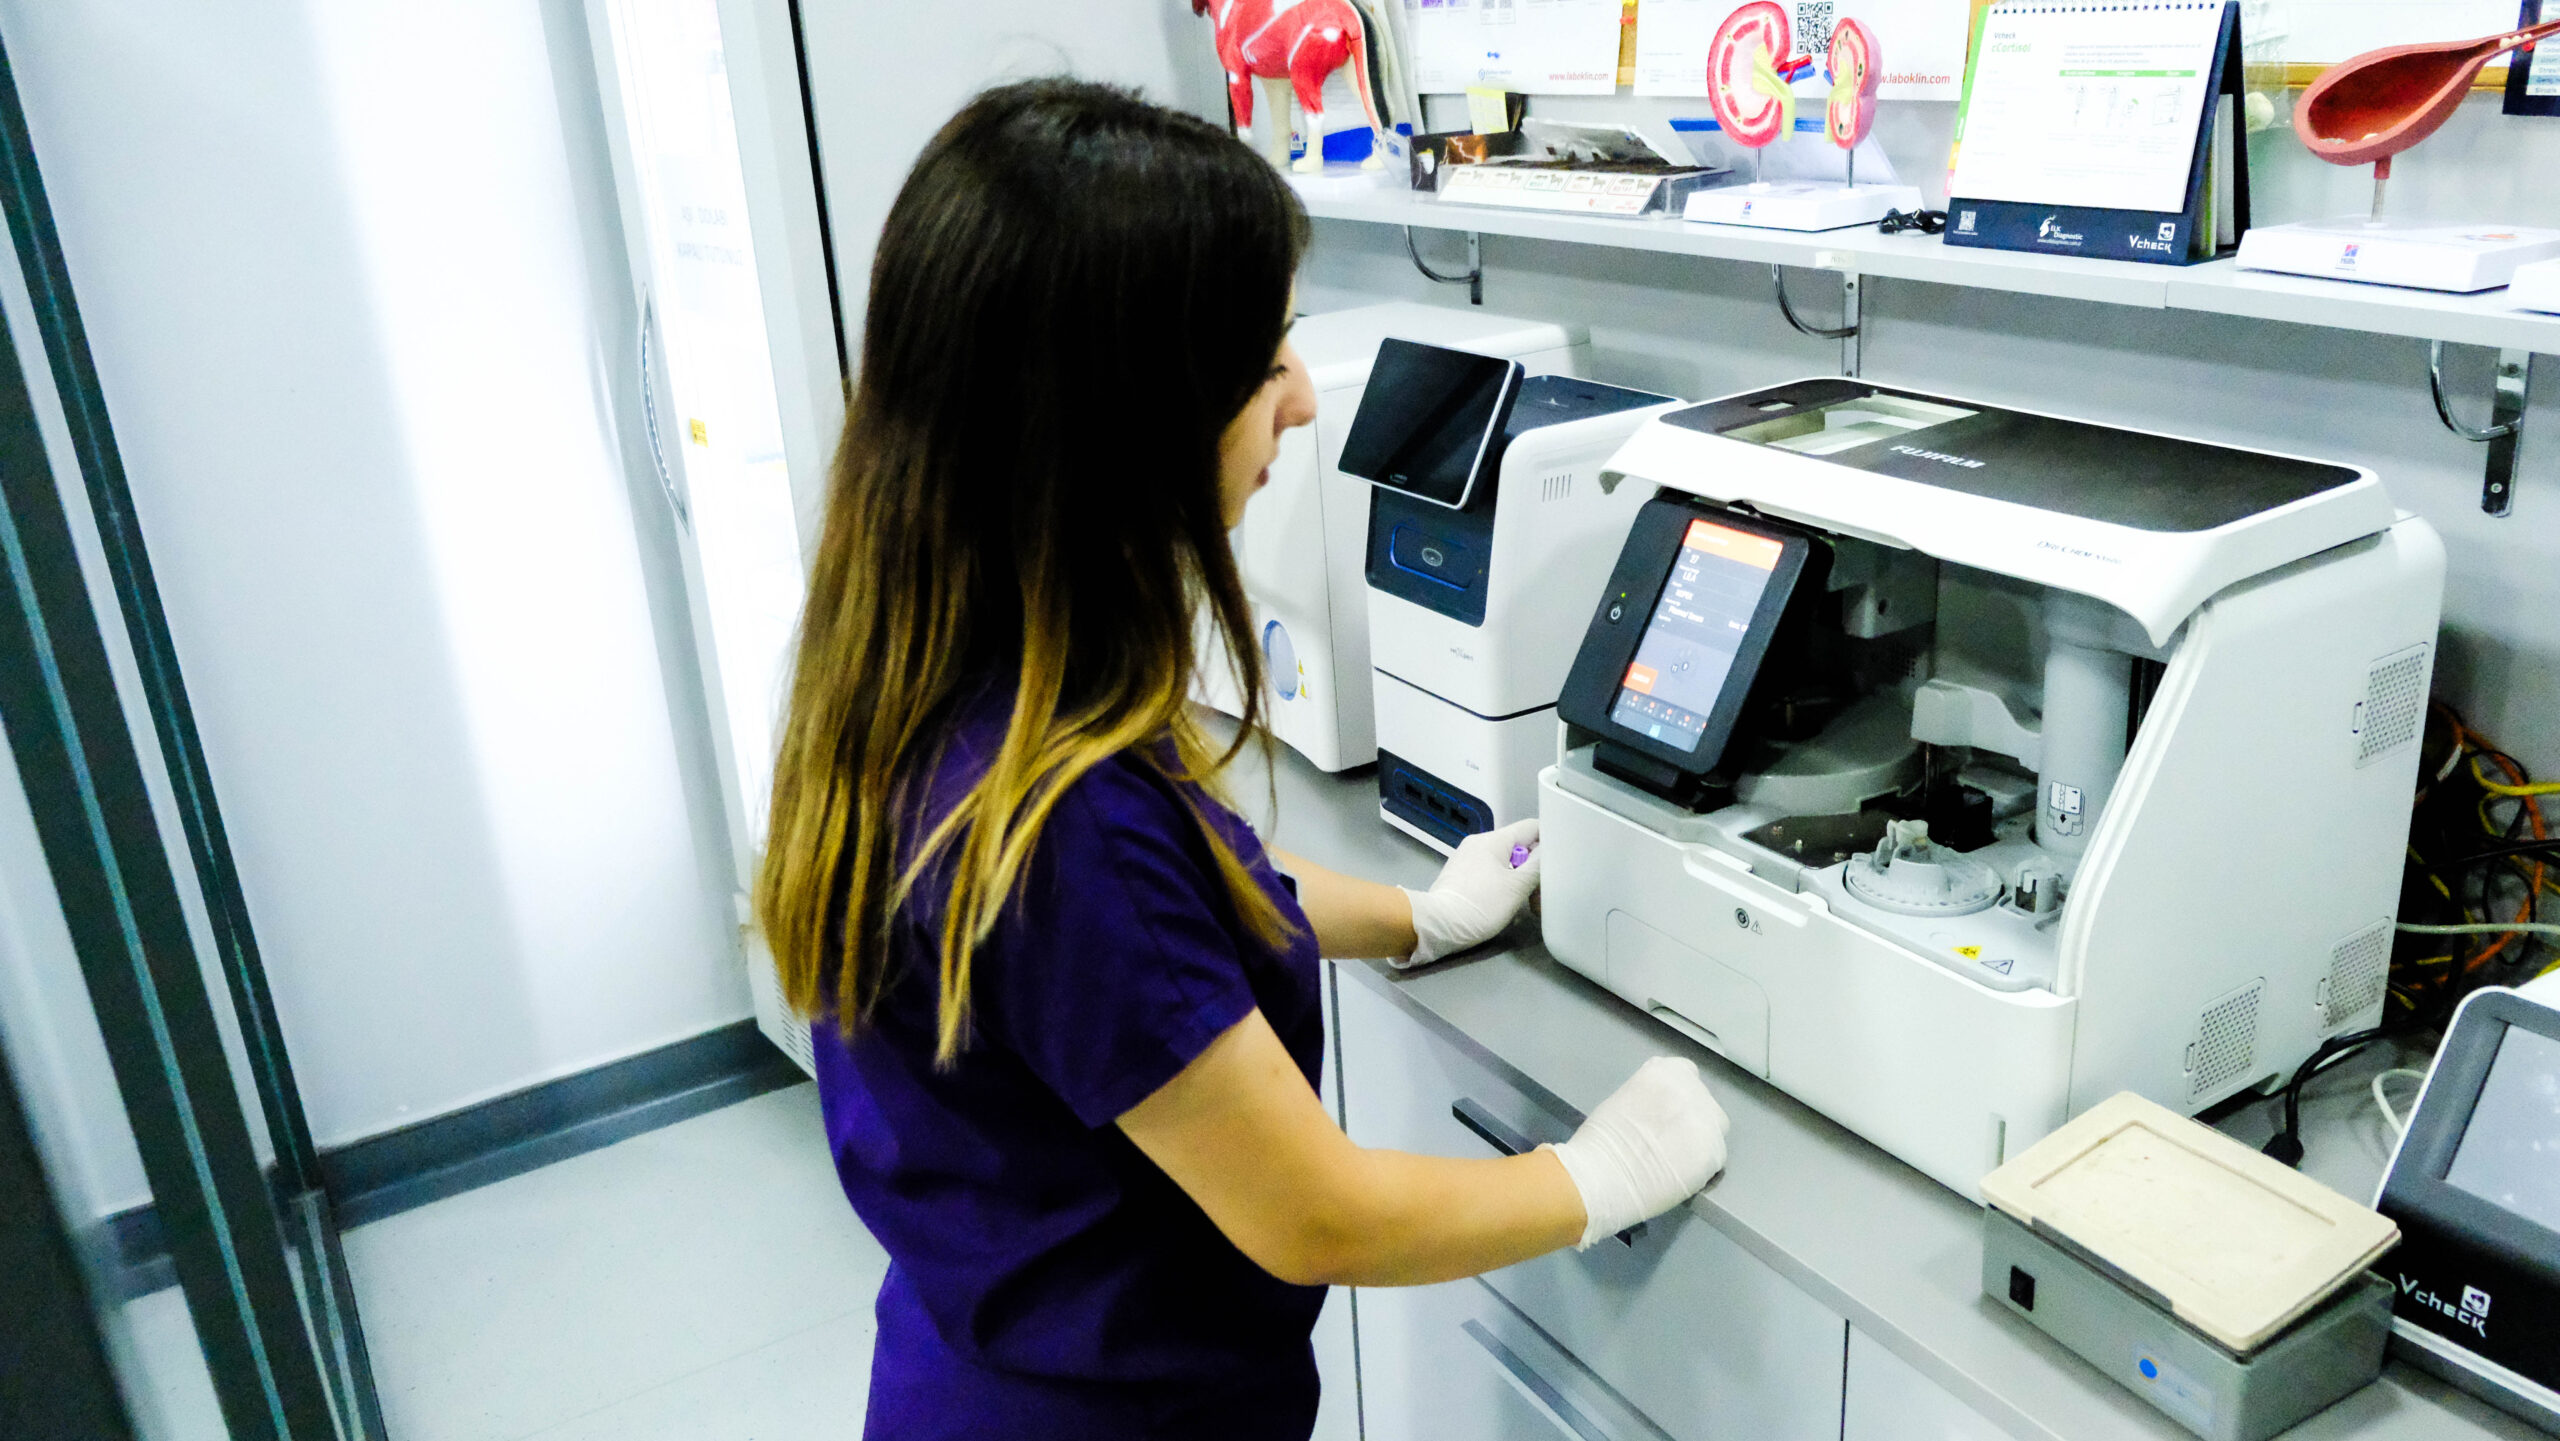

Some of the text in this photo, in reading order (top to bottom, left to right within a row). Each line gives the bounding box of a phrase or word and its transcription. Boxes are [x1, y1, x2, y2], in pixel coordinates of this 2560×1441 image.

[1547, 71, 1609, 81] www.laboklin.com
[1881, 71, 1951, 84] w.laboklin.com
[1889, 444, 1987, 469] FUJIFILM
